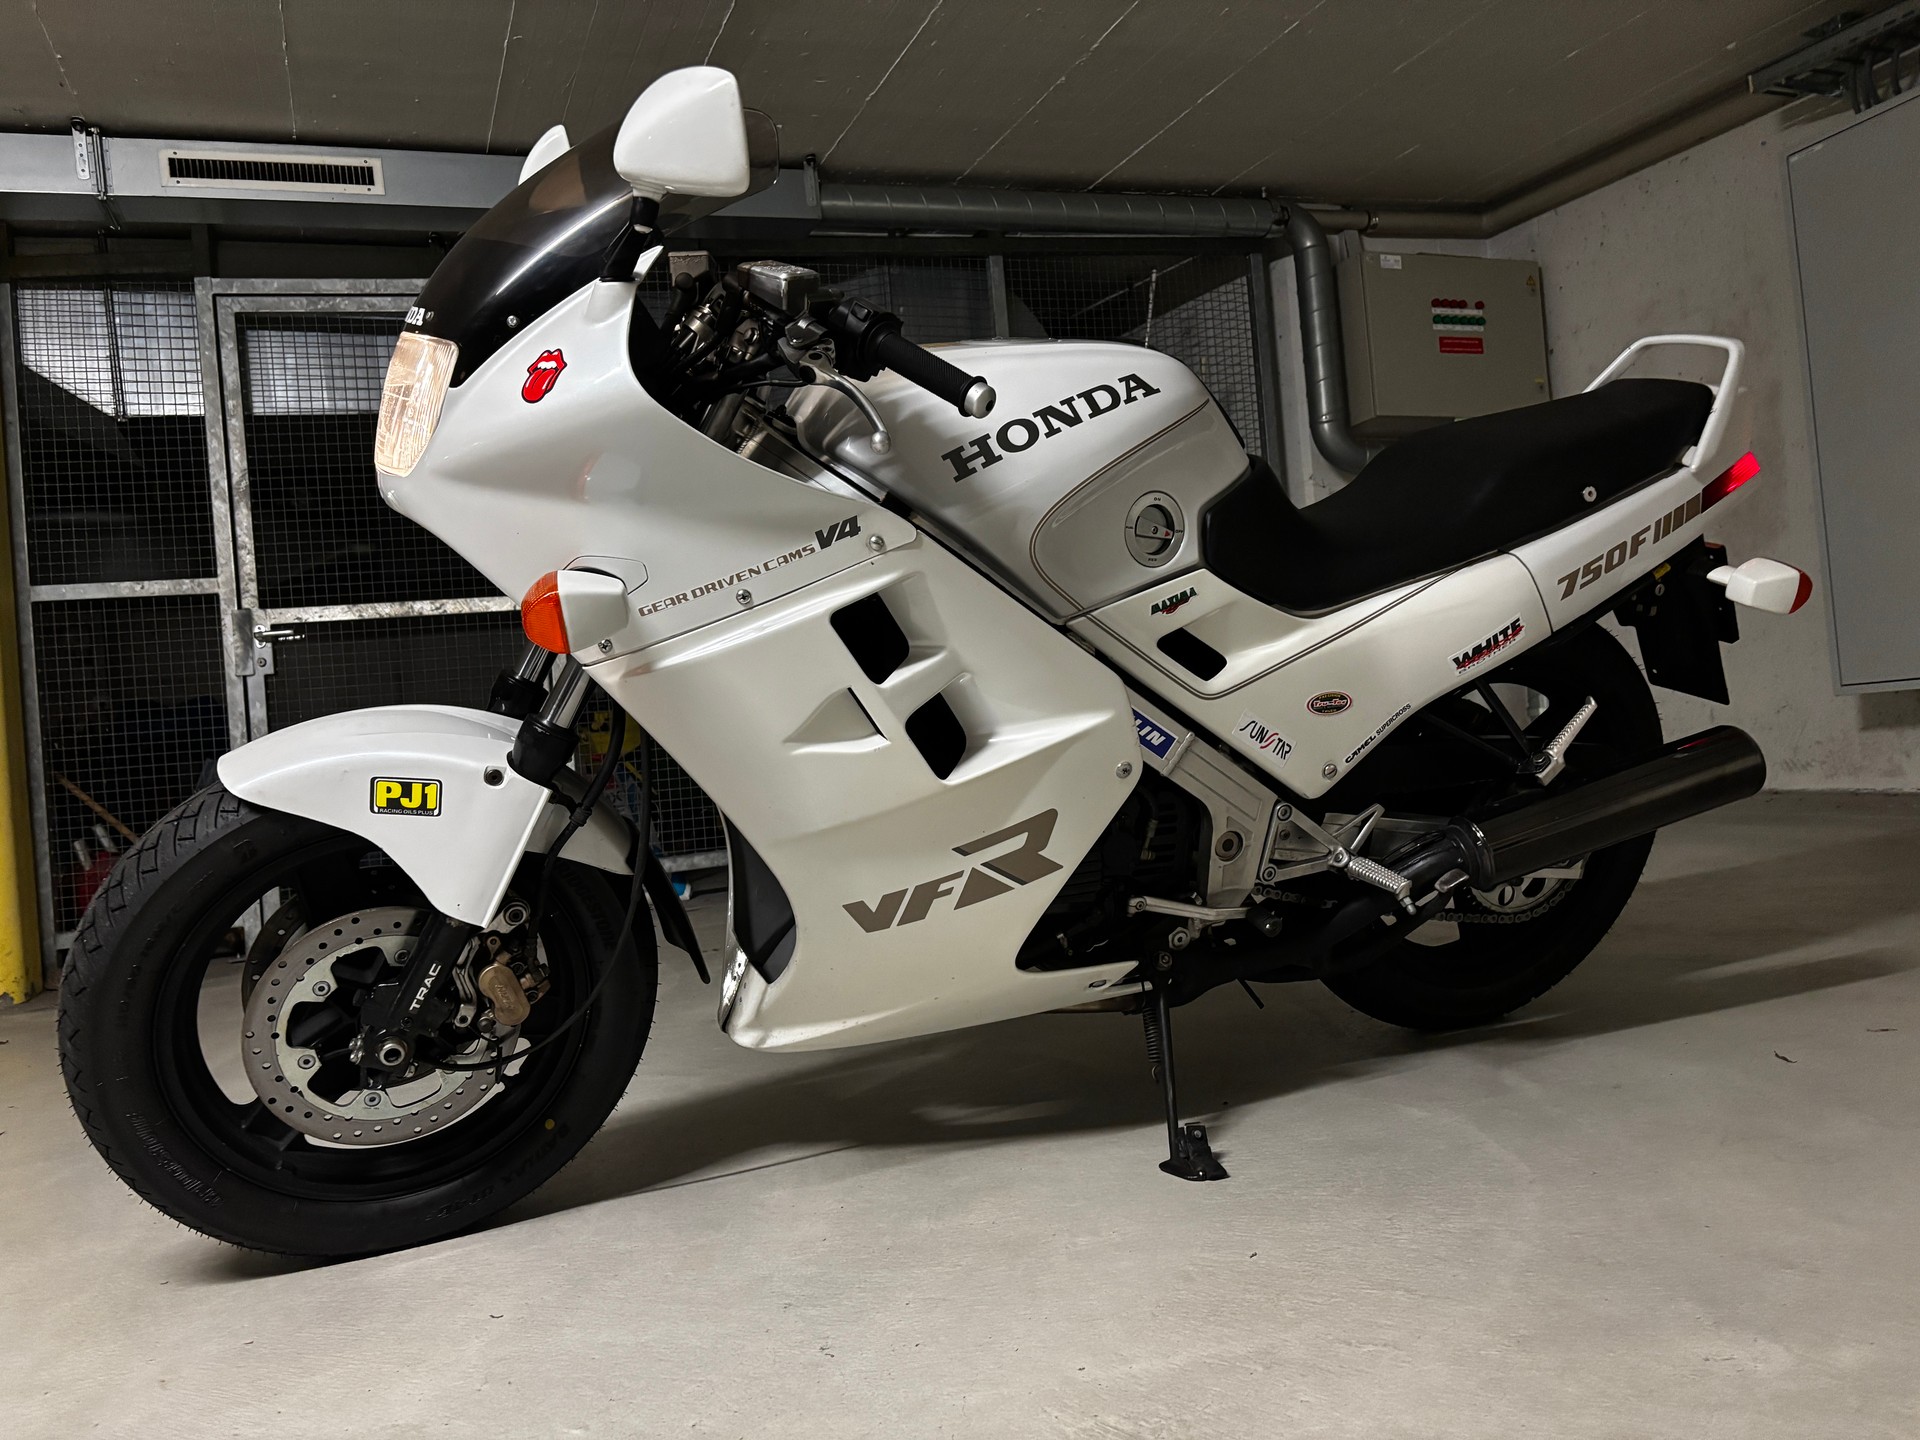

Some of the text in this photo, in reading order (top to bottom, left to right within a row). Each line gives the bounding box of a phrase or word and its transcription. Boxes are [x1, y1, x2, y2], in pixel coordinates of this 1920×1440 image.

[405, 306, 425, 326] DA
[941, 373, 1161, 483] HONDA
[638, 515, 861, 617] GEAR DRIVEN CAMS V4
[1557, 524, 1651, 600] 750F
[1452, 617, 1522, 668] WHITE
[1239, 720, 1292, 760] SUNSTAR
[1345, 703, 1412, 764] CAMEL SUPERCROSS
[376, 781, 437, 809] PJ1
[842, 808, 1064, 933] VFR
[409, 963, 442, 1012] TRAC
